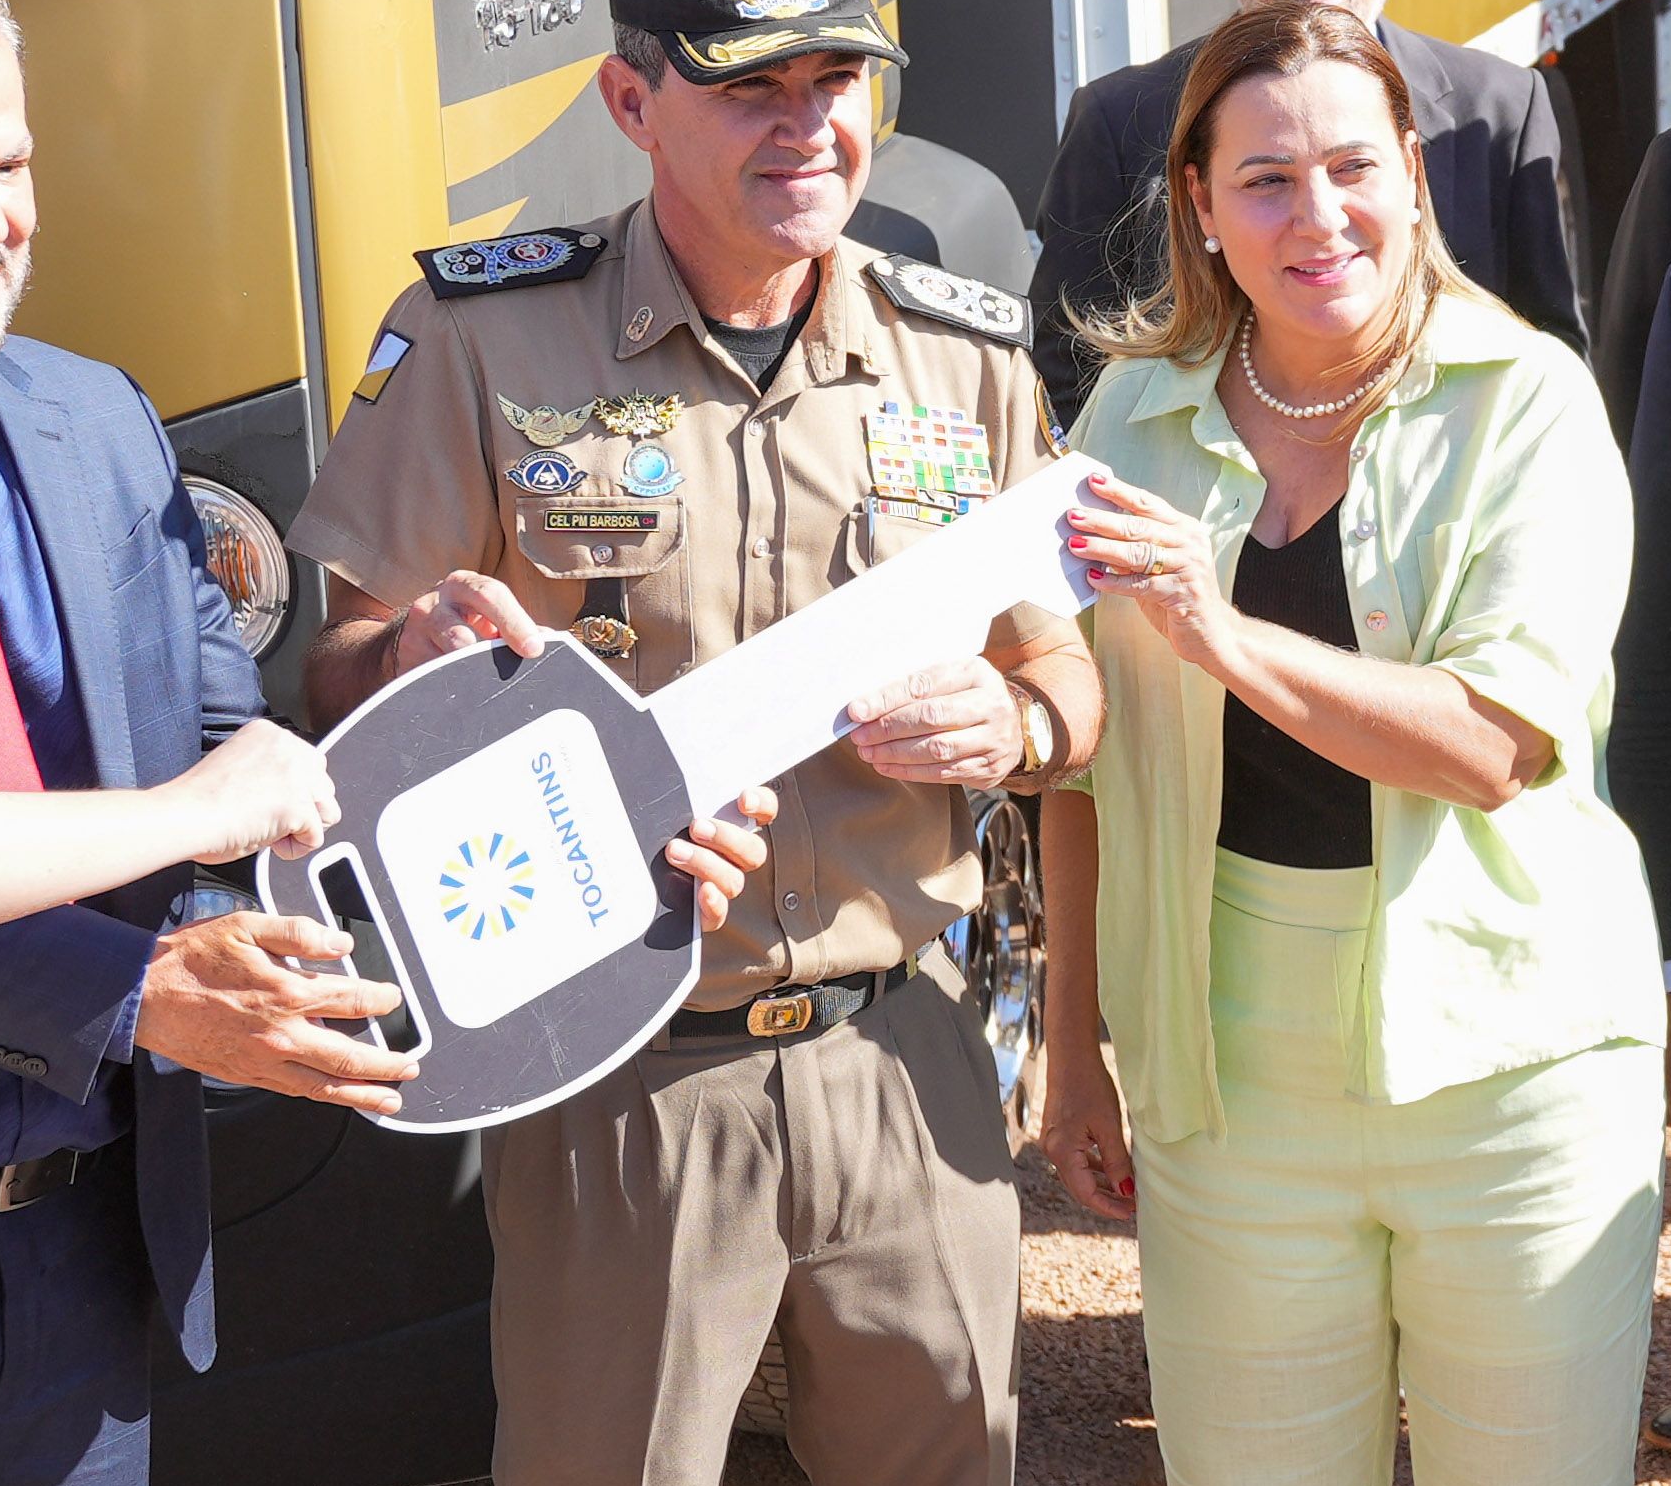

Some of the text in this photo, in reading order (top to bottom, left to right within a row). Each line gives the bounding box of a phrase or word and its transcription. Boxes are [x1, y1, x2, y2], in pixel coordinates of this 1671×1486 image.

[549, 514, 571, 527] CEL
[572, 515, 588, 527] PM
[589, 514, 641, 528] BARBOSA
[532, 751, 609, 928] TOCANTINS
